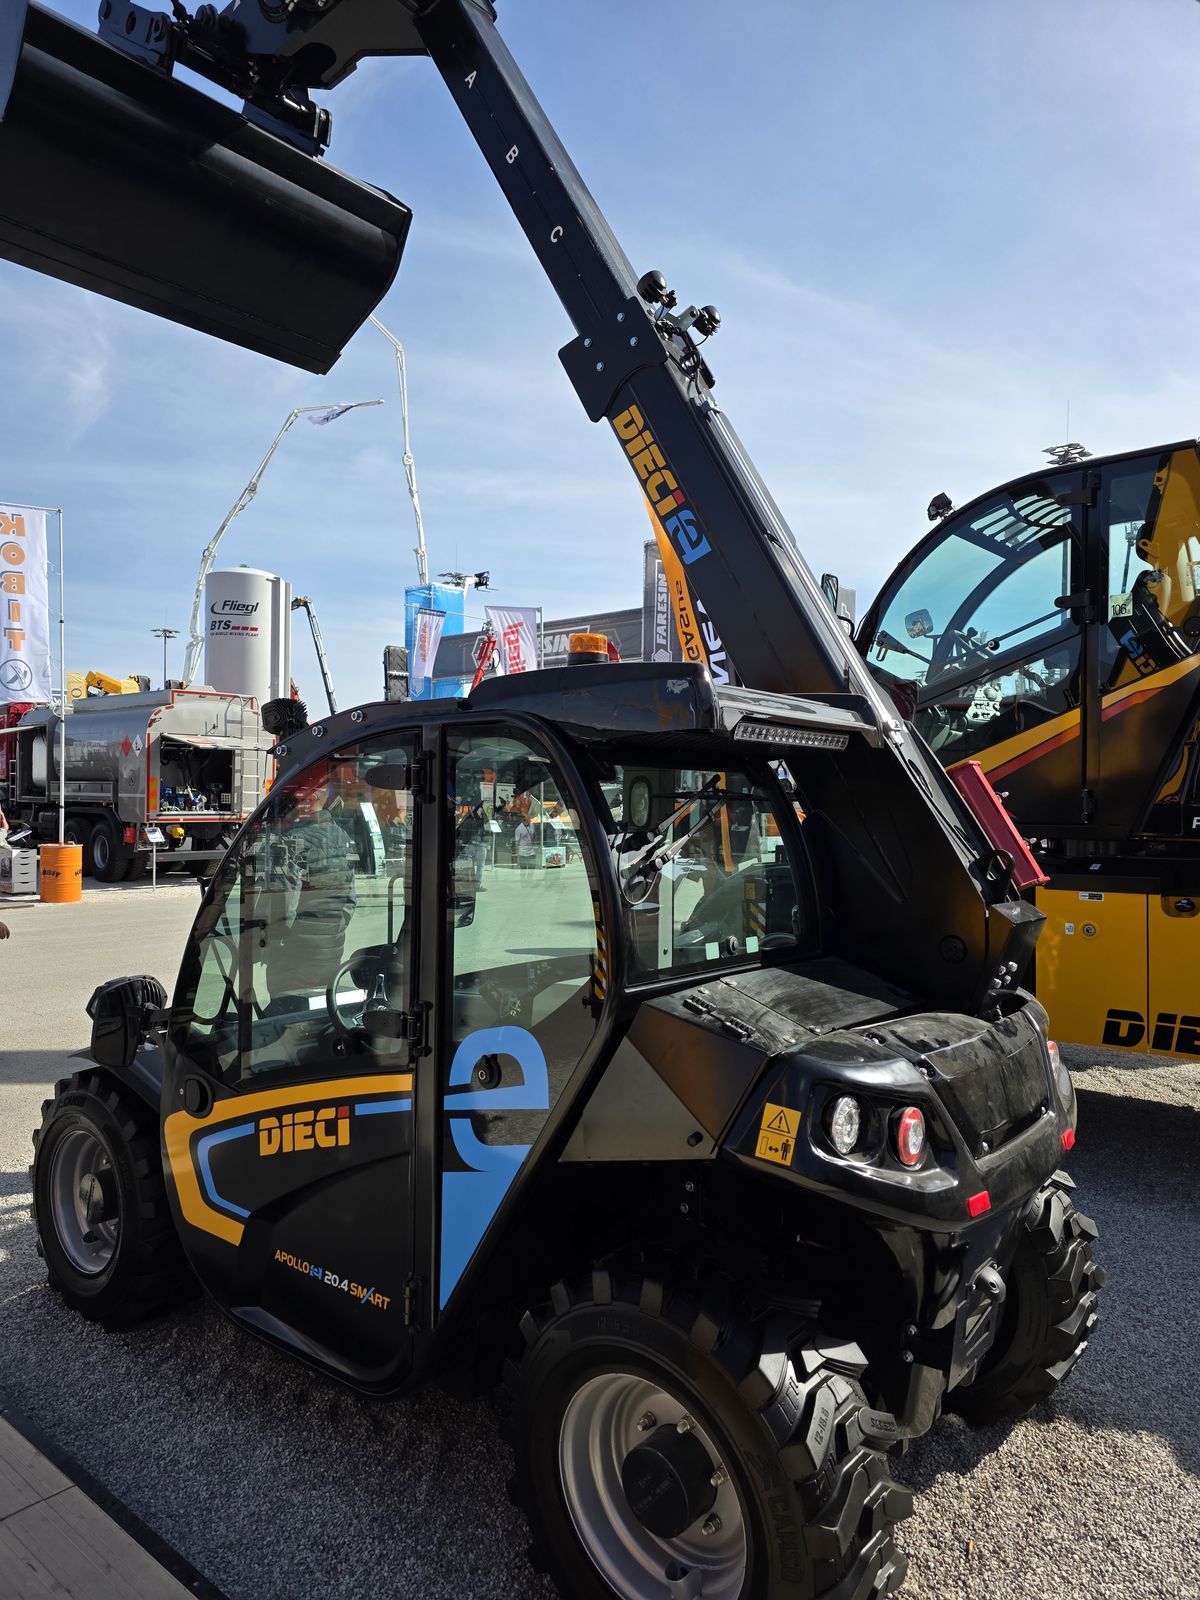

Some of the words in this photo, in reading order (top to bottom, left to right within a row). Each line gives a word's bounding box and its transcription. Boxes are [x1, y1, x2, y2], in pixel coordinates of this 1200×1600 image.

[463, 69, 477, 89] A
[505, 144, 520, 165] B
[550, 225, 564, 244] C
[221, 600, 259, 614] Fliegl
[1111, 604, 1127, 617] 106
[210, 620, 232, 631] BTS
[258, 1105, 350, 1156] DIECI
[274, 1249, 310, 1274] APOLLO
[324, 1270, 349, 1292] 20.4
[350, 1282, 391, 1311] SMART
